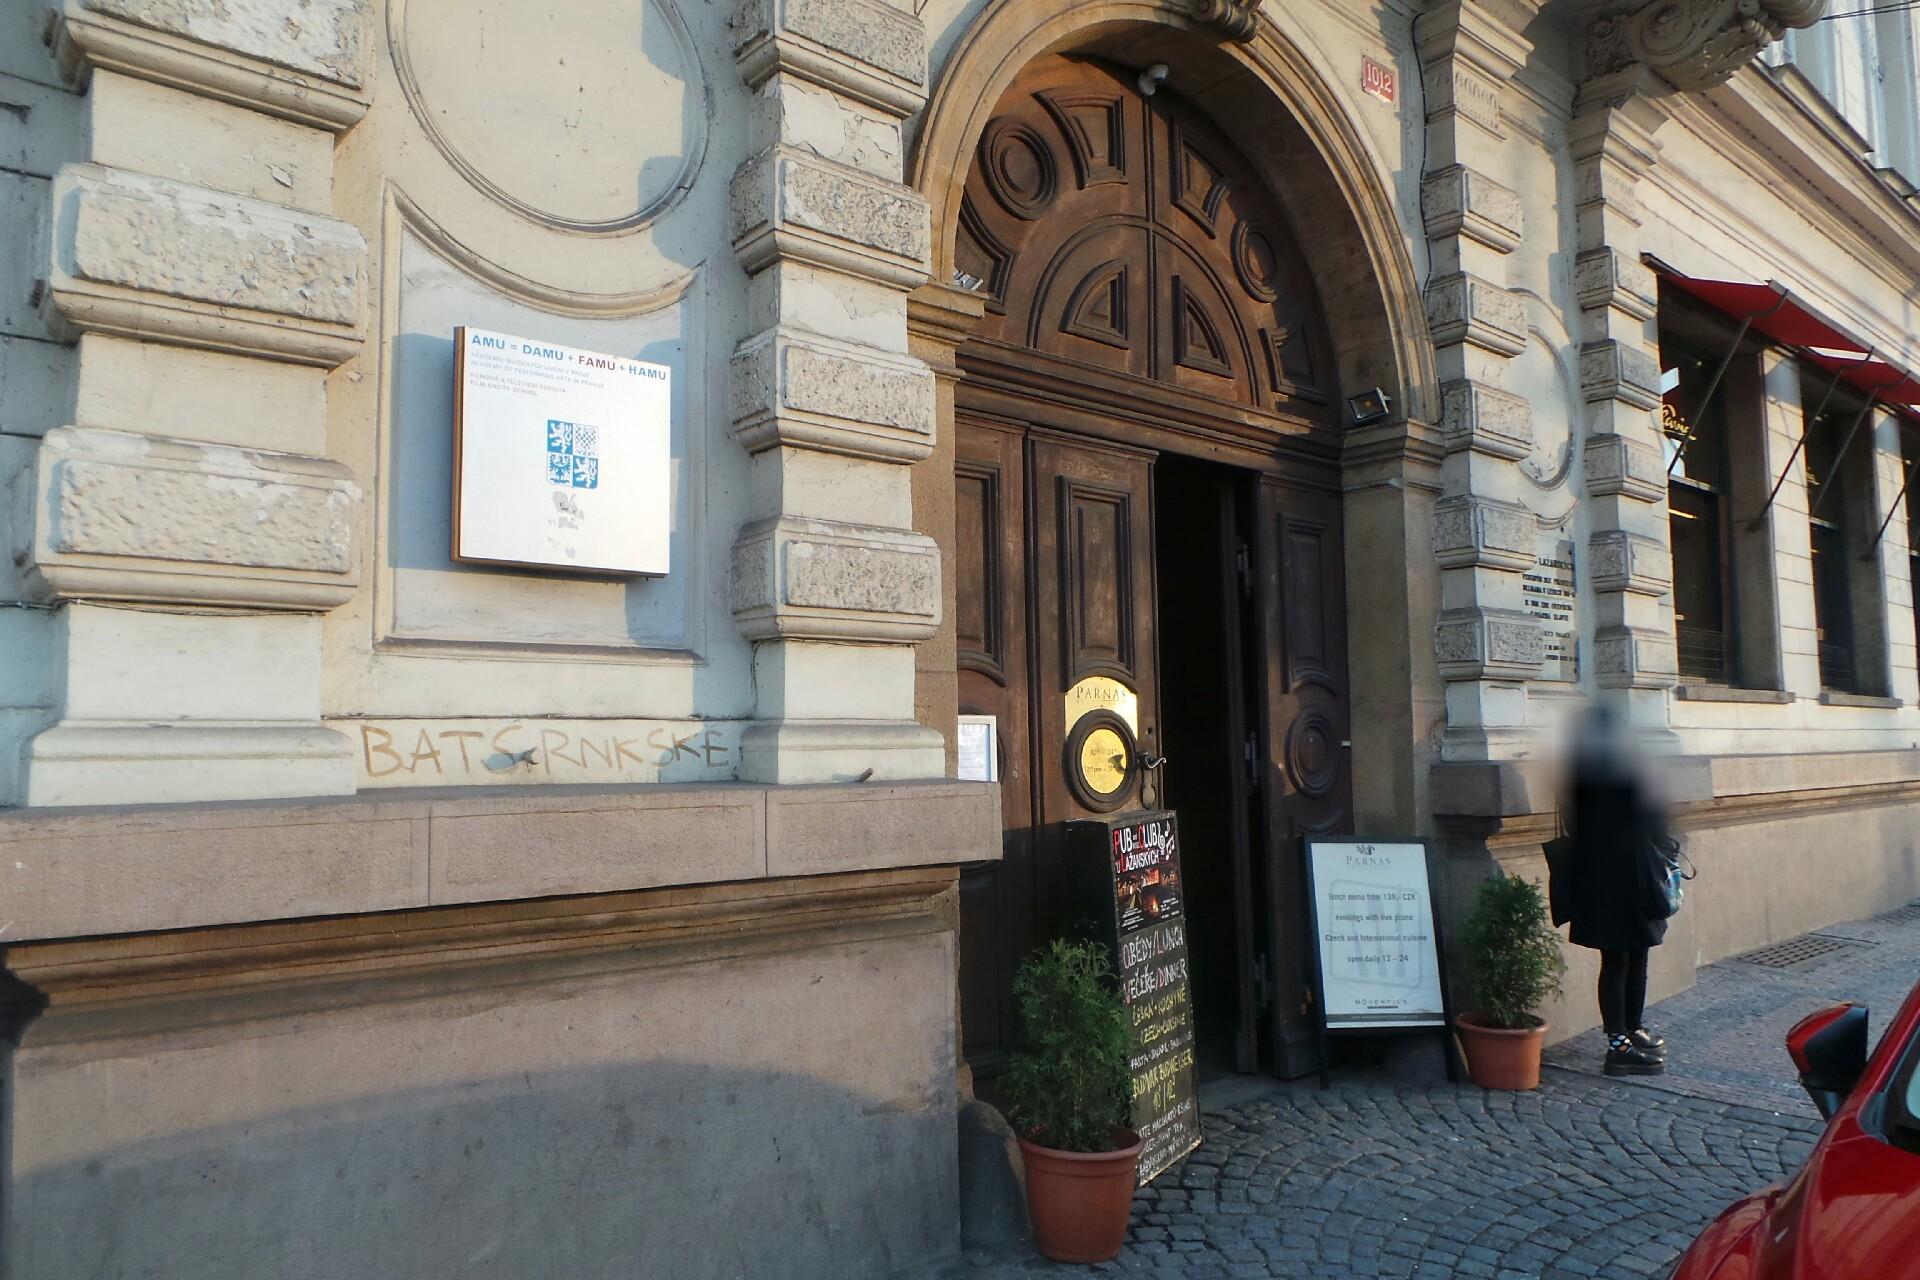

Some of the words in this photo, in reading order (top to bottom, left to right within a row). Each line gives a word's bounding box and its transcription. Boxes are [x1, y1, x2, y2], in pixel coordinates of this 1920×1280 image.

[1367, 63, 1392, 93] 1012
[472, 335, 505, 350] AMU
[522, 344, 564, 361] DAMU
[578, 355, 616, 371] FAMU
[629, 365, 667, 380] HAMU
[1075, 685, 1126, 700] PARNAS
[1112, 826, 1133, 854] PUB
[1137, 821, 1158, 849] CLUB
[1346, 855, 1392, 865] PARNAS
[1365, 913, 1379, 921] with
[1325, 934, 1345, 942] Czech
